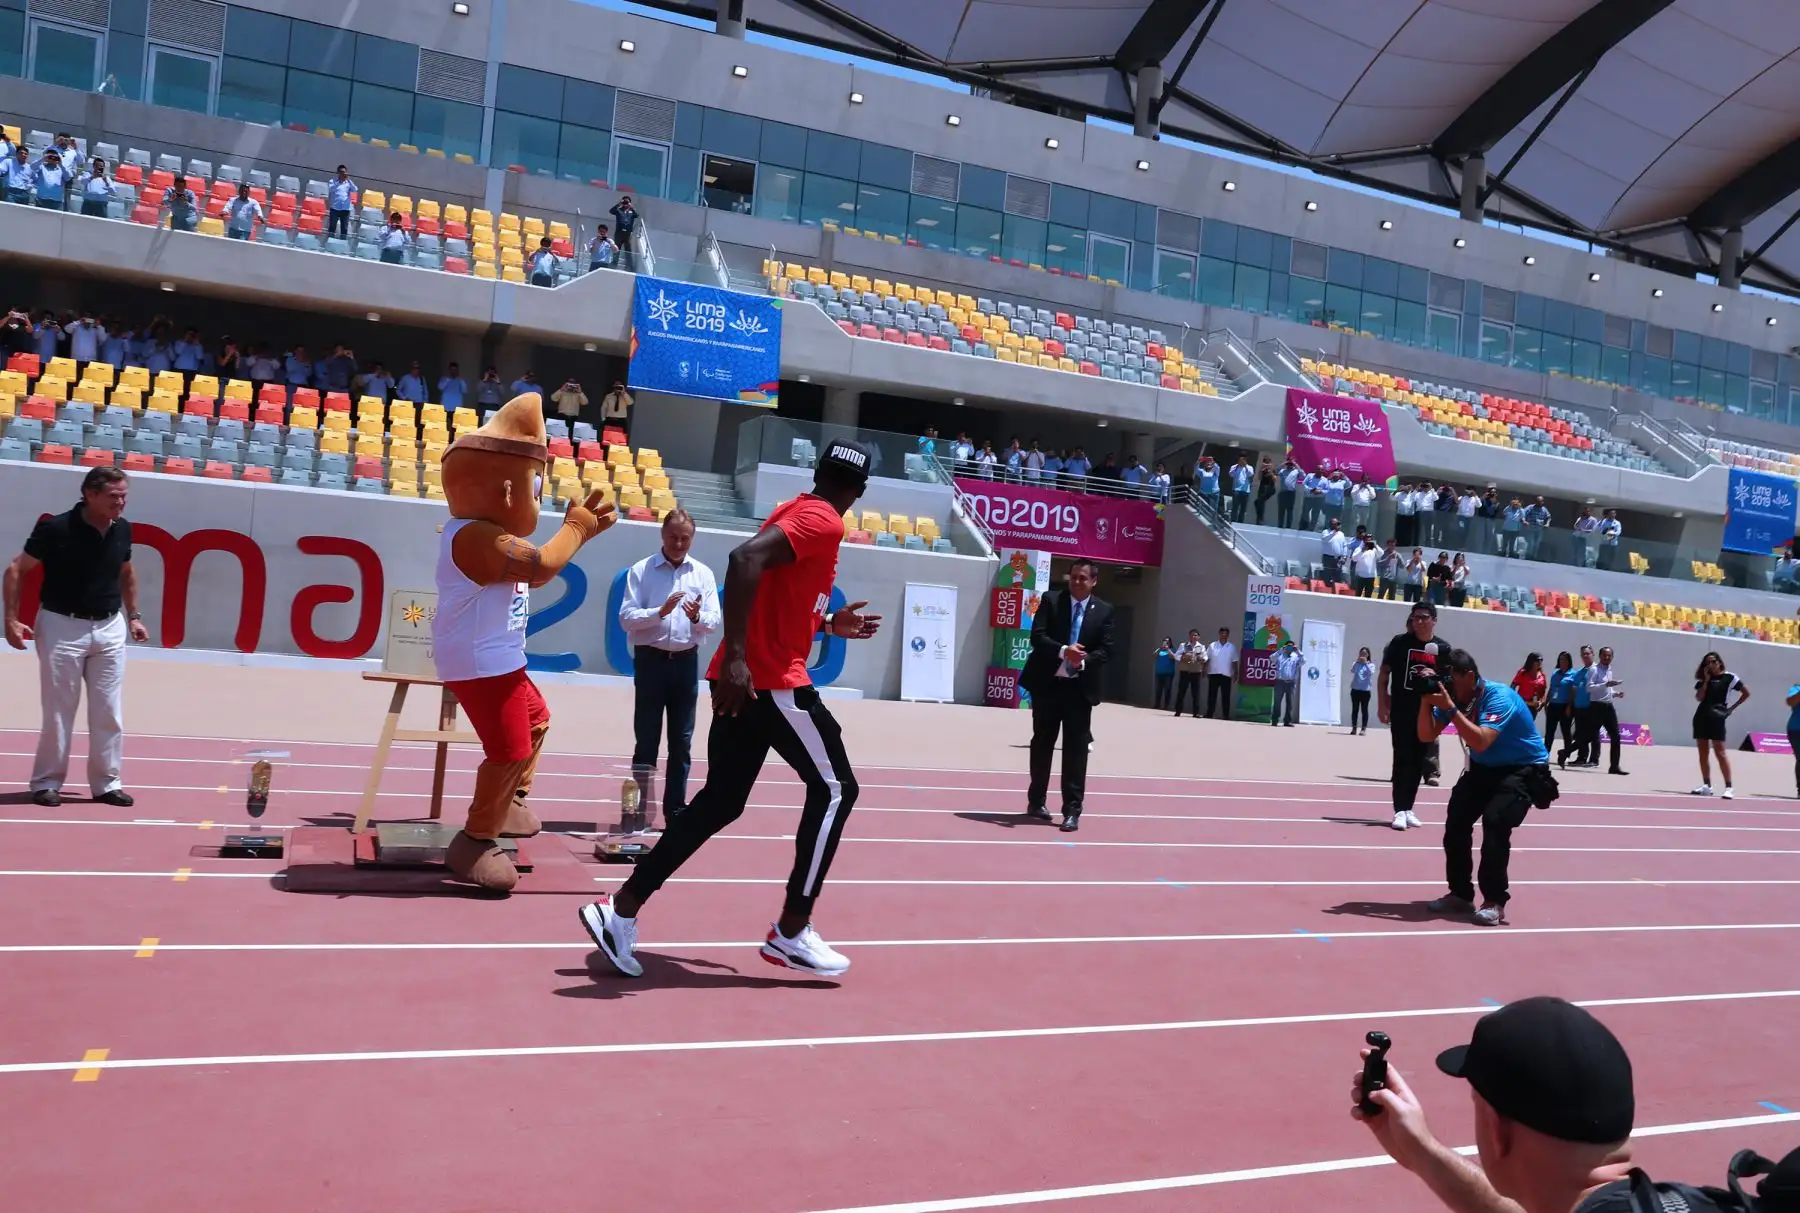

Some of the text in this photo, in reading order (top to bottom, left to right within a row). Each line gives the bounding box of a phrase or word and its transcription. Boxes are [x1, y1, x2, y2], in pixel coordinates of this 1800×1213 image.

[686, 301, 725, 317] Lima
[686, 315, 725, 332] 2019
[1322, 408, 1350, 420] Lima
[1323, 419, 1351, 433] 2019
[831, 446, 866, 468] PUMA
[1012, 530, 1079, 545] PARAPANAMERICANOS
[1250, 583, 1281, 594] Lima
[1250, 594, 1281, 606] 2019
[996, 591, 1008, 625] 2019
[1007, 591, 1017, 625] Lima
[988, 674, 1015, 688] Lima
[1246, 667, 1277, 681] 2019
[987, 686, 1014, 700] 2019
